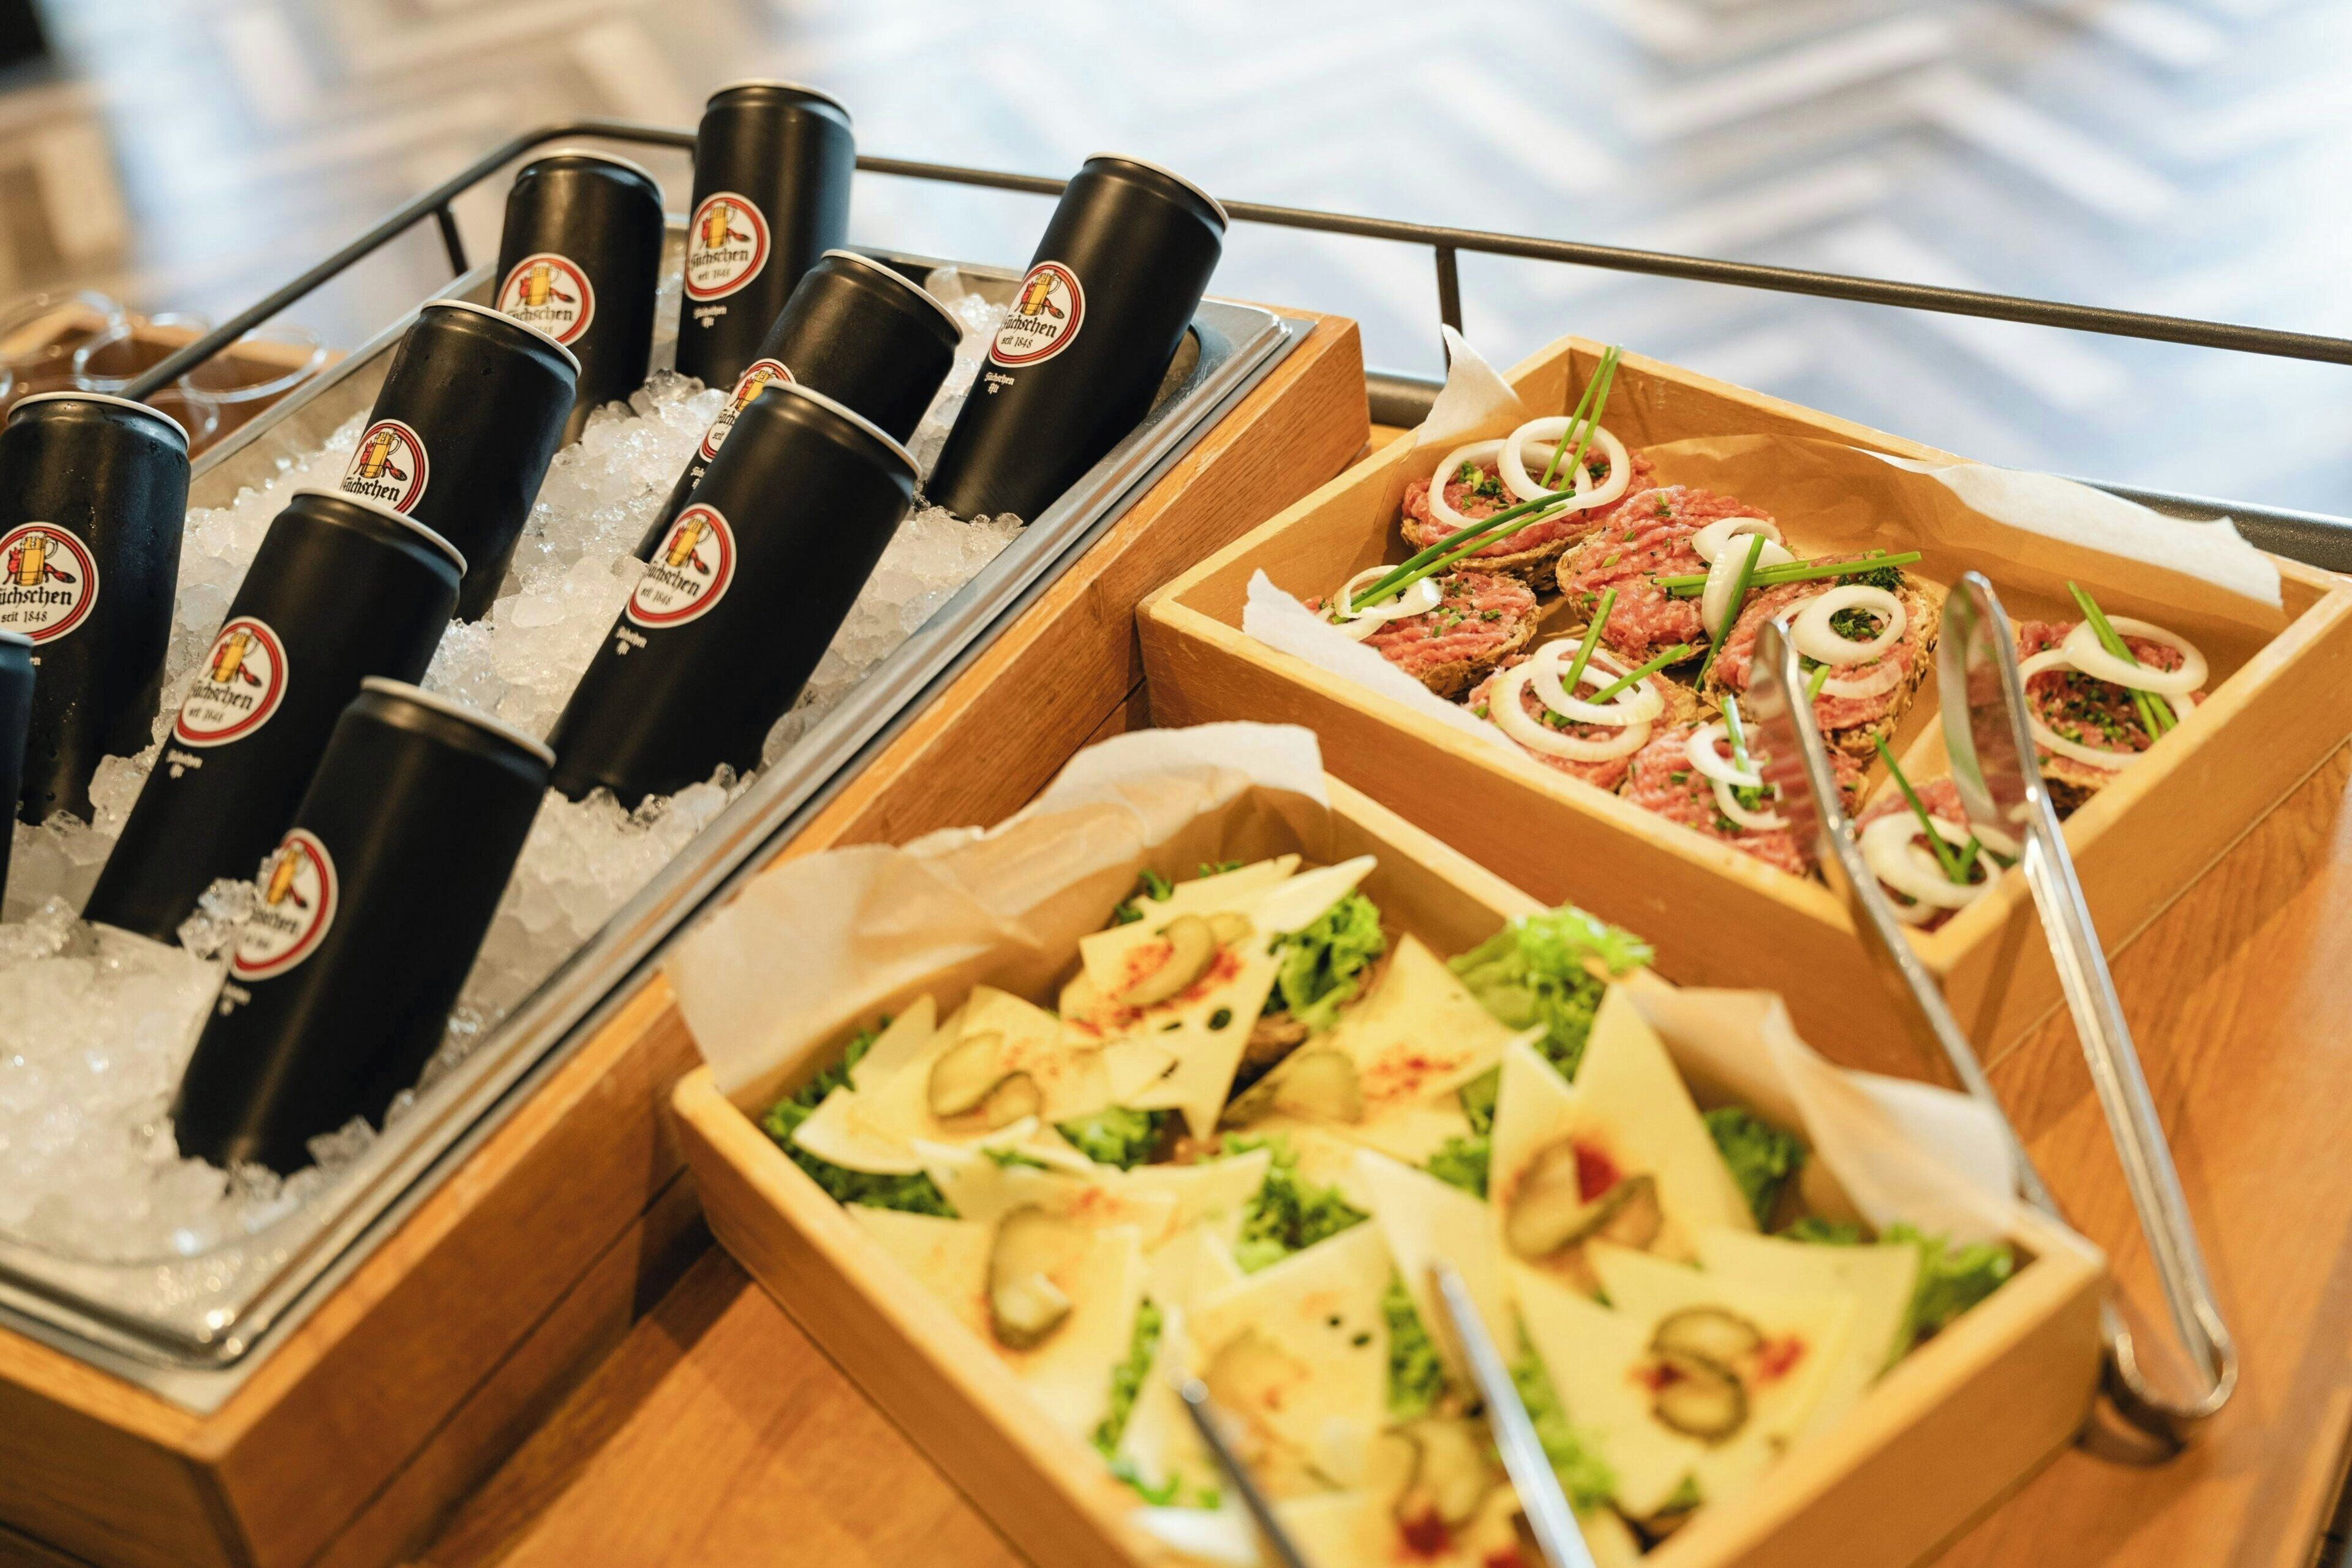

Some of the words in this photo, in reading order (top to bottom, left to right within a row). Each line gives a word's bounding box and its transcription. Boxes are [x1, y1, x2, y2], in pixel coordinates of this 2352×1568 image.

[1001, 335, 1014, 345] seit
[1014, 336, 1033, 349] 1848
[0, 586, 72, 608] üchschen
[1, 612, 18, 623] seit
[24, 611, 47, 624] 1848
